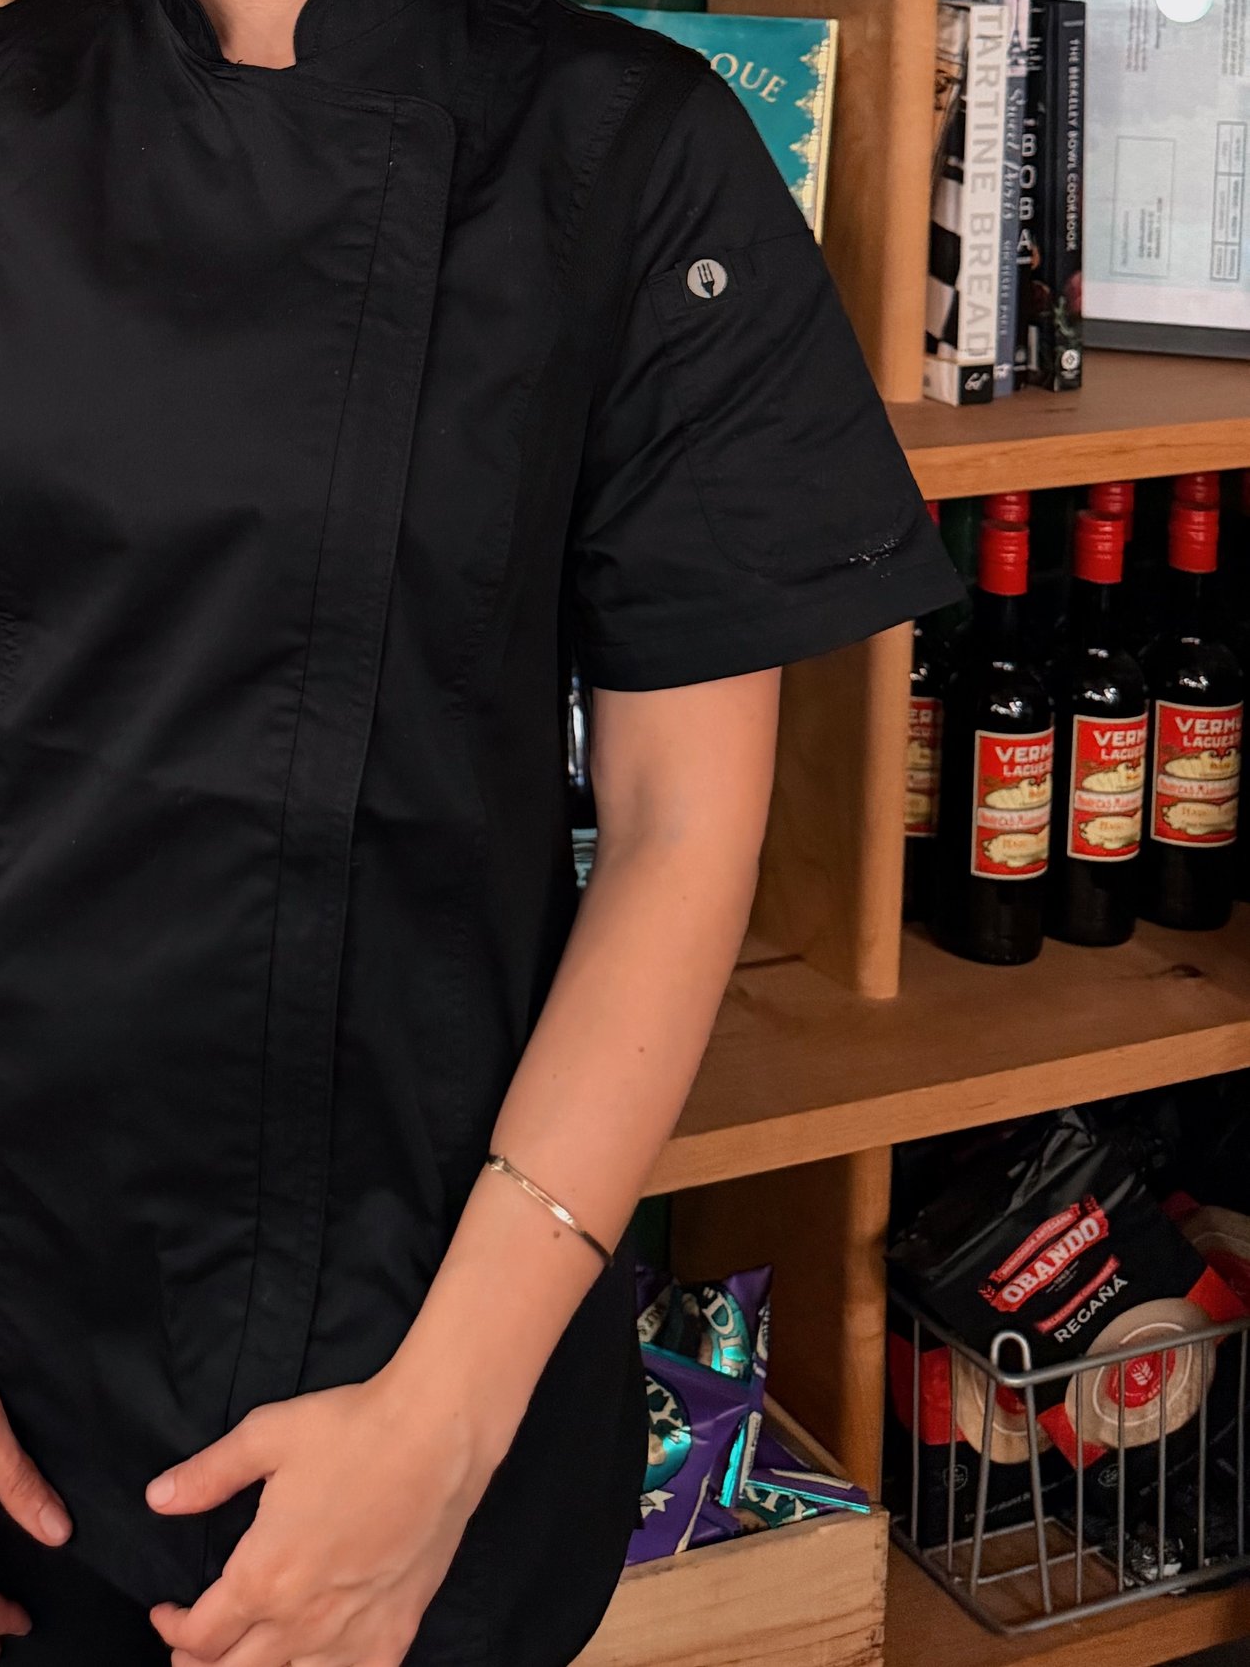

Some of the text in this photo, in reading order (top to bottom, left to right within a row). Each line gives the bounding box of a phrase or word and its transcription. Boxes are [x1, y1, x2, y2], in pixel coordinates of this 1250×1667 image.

[964, 7, 1006, 360] TARTINE BREAD
[1018, 133, 1038, 253] BOBA
[1066, 38, 1079, 251] THE BERKELEY BOWL COOKBOOK
[1002, 1217, 1100, 1304] OBANDO
